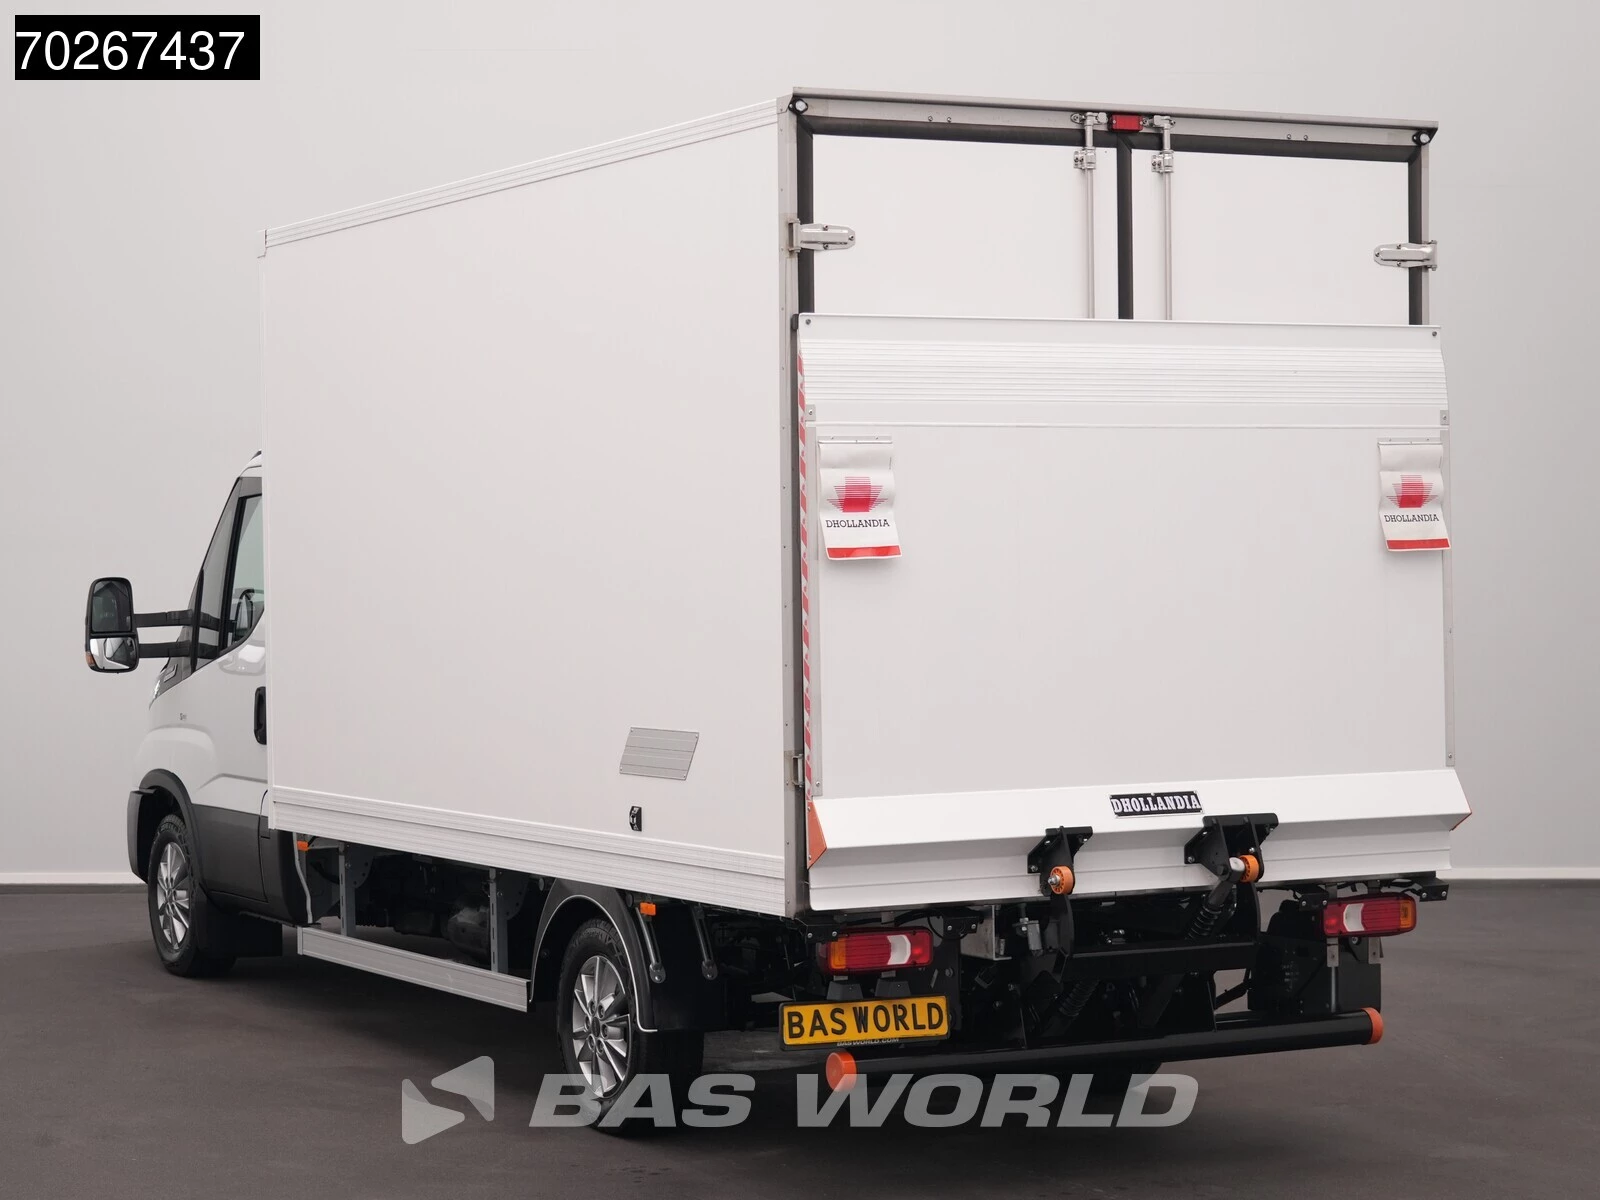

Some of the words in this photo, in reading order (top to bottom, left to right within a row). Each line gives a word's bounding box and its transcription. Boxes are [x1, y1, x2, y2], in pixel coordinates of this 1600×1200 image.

[826, 519, 890, 528] DHOLLANDIA
[1384, 514, 1439, 522] DHOLLANDIA
[1110, 795, 1201, 813] DHOLLANDIA
[787, 1007, 847, 1039] BAS
[853, 1003, 944, 1033] WORLD
